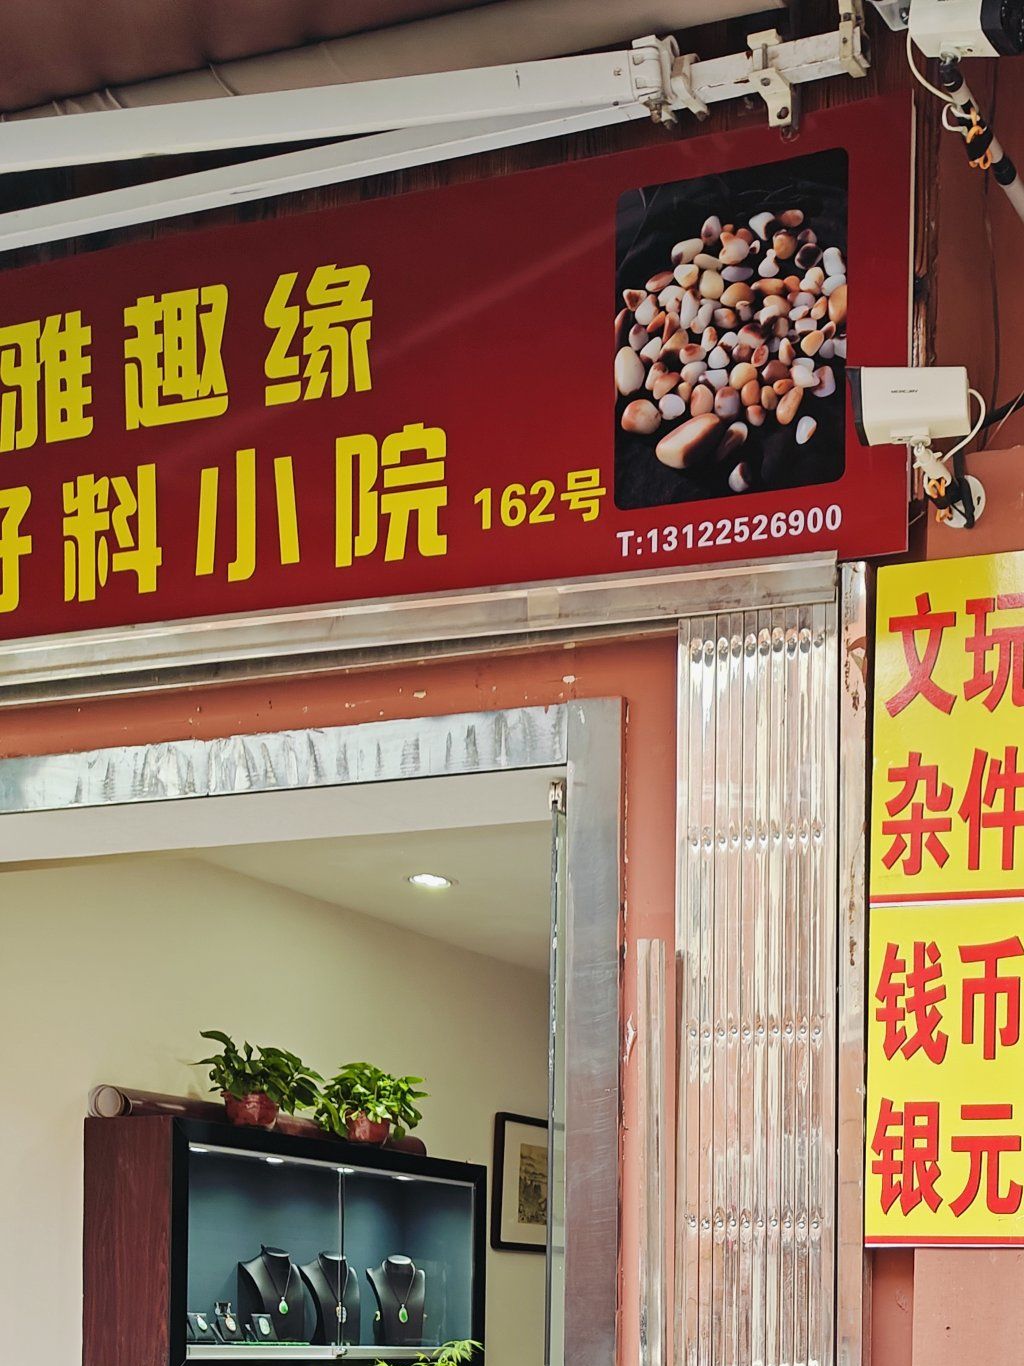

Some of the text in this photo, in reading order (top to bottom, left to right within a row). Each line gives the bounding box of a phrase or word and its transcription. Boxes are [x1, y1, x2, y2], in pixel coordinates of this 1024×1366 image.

[0, 263, 374, 453] 雅趣缘
[472, 466, 607, 532] 162号
[616, 503, 843, 558] T:13122526900
[869, 1096, 1024, 1218] 银元
